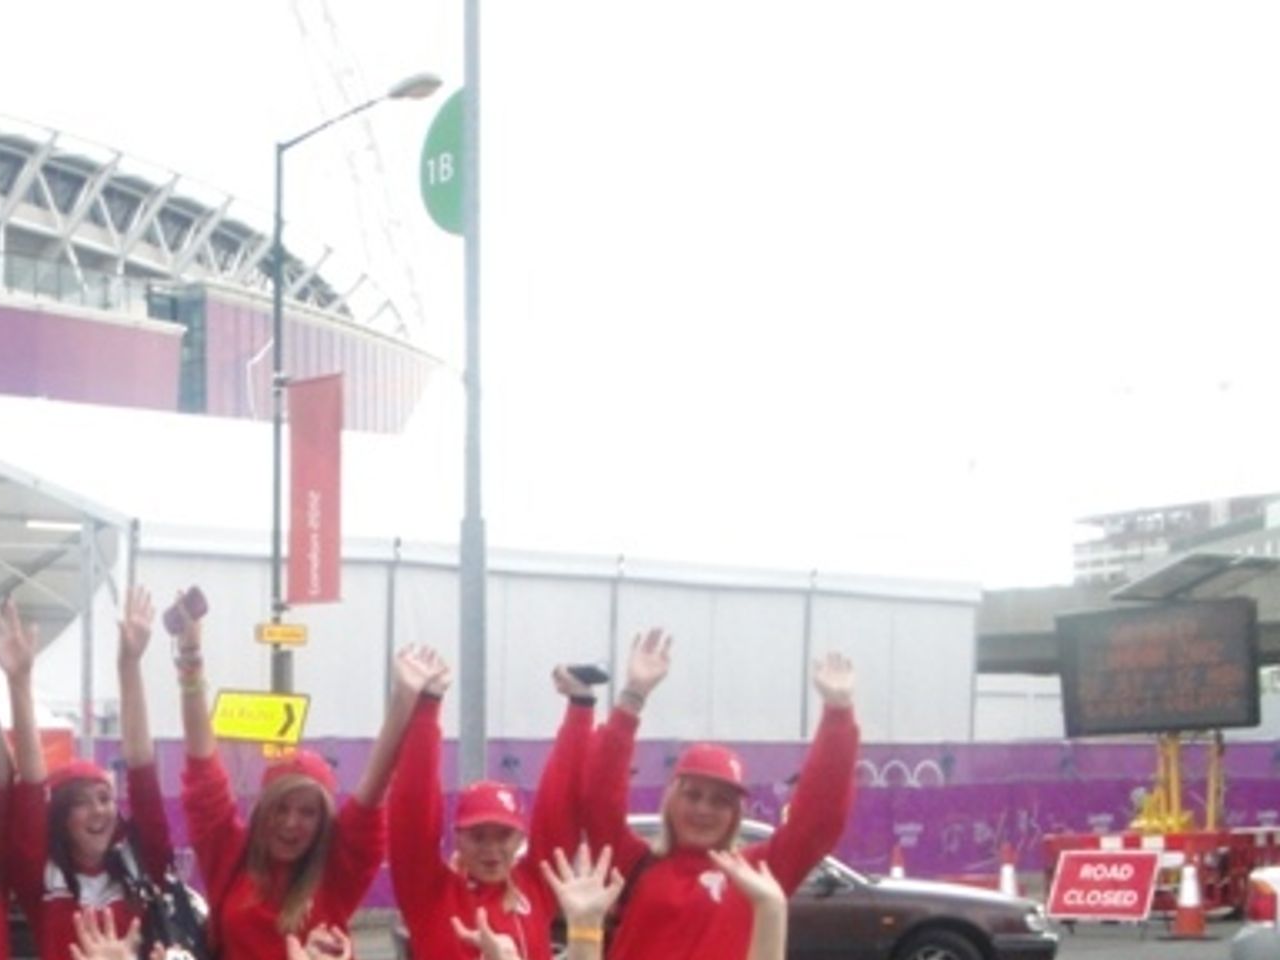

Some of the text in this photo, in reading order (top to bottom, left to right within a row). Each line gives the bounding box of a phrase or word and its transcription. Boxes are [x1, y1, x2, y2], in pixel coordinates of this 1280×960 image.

[427, 151, 454, 186] 1B
[1079, 862, 1136, 881] ROAD
[1063, 889, 1139, 908] CLOSED
